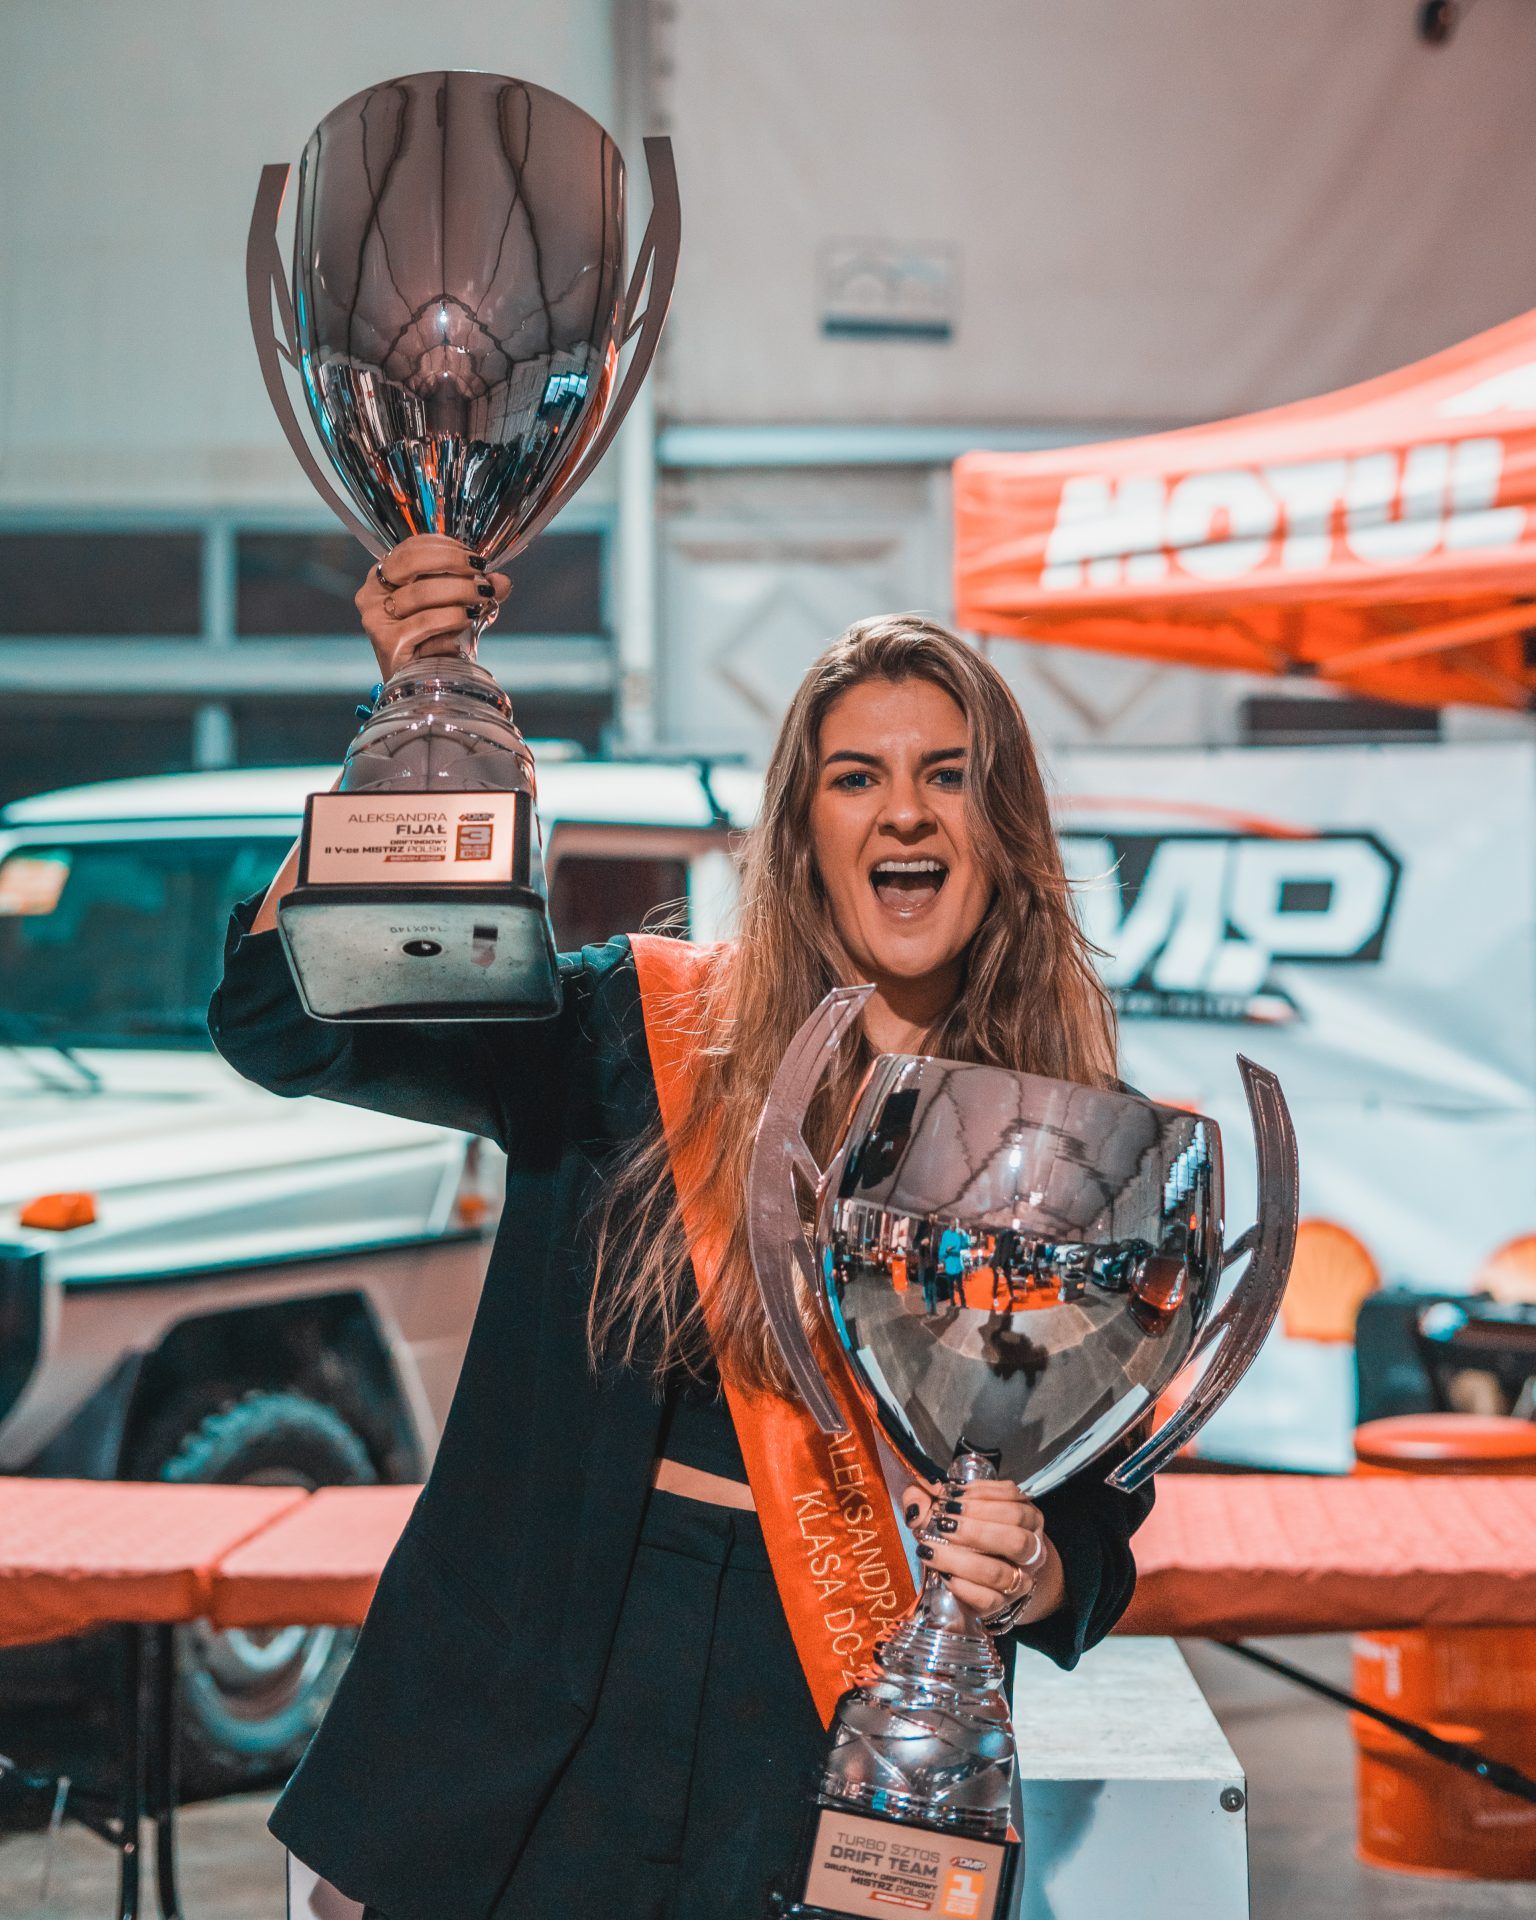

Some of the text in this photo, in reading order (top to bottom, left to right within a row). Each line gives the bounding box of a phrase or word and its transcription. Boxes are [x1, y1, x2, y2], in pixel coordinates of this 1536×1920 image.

[1039, 436, 1527, 590] MOTUL
[348, 812, 448, 823] ALEKSANDRA
[395, 823, 448, 835] FIJAŁ
[362, 846, 405, 854] MISTRZ
[407, 845, 447, 853] POLSKI
[792, 1490, 847, 1601] KLASA
[838, 1832, 941, 1864] TURBO SZTOS
[830, 1844, 938, 1879] DRIFT TEAM
[850, 1875, 936, 1901] MISTRZ POLSKI
[950, 1874, 978, 1900] 1
